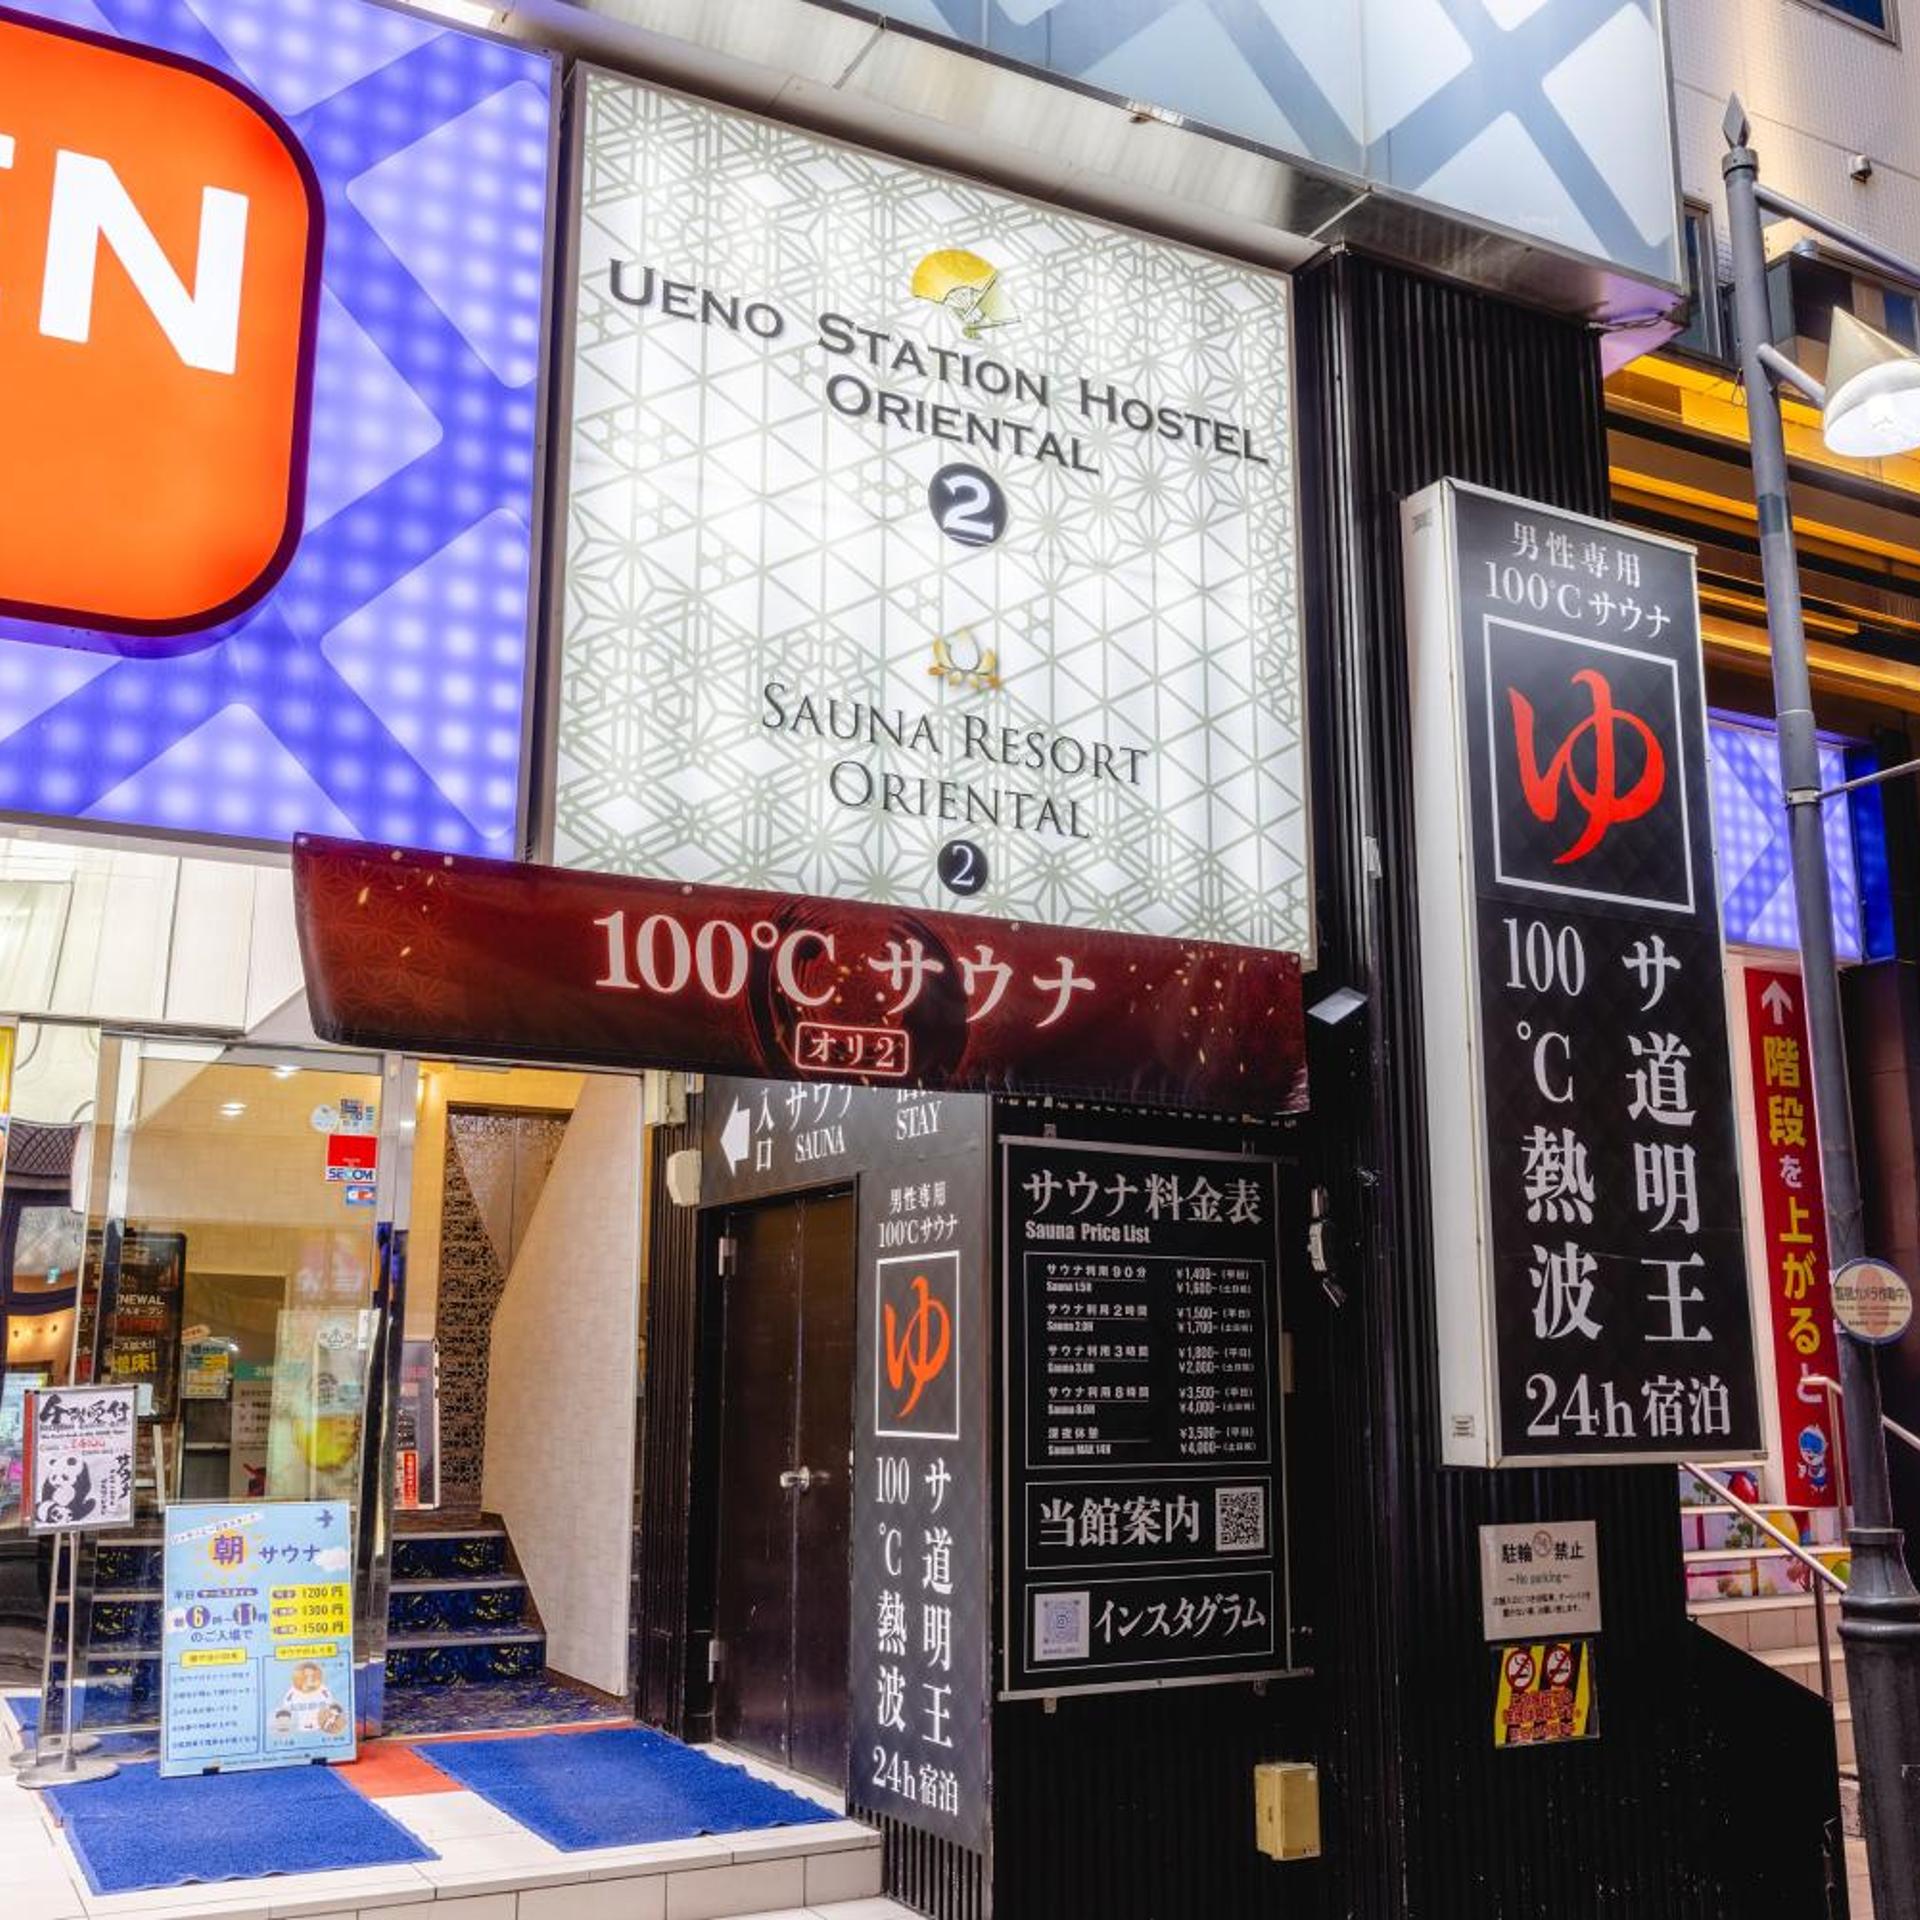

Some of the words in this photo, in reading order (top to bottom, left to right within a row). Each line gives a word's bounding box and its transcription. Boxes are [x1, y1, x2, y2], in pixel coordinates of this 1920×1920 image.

[609, 259, 783, 339] UENO
[818, 312, 1049, 406] STATION
[1078, 376, 1270, 463] HOSTEL
[826, 373, 1099, 474] ORIENTAL
[943, 476, 996, 542] 2
[1513, 520, 1641, 588] 男性専用
[762, 682, 940, 754] SAUNA
[963, 713, 1148, 786] RESORT
[1508, 669, 1665, 865] ゆ
[829, 760, 1091, 838] ORIENTAL
[948, 848, 976, 886] 2
[807, 1031, 895, 1068] オリ2
[755, 1088, 775, 1173] 入口
[795, 1124, 846, 1163] SAUNA
[896, 1101, 942, 1140] STAY
[1622, 935, 1713, 1342] サ道明王
[328, 1168, 373, 1180] SECOM
[889, 1181, 947, 1215] 男性専用
[1022, 1170, 1262, 1225] サウナ料金表
[1026, 1220, 1075, 1240] Sauna
[1081, 1223, 1120, 1242] Price
[1123, 1224, 1151, 1243] List
[884, 1275, 950, 1418] ゆ
[1039, 1495, 1199, 1547] 当館案内
[212, 1535, 244, 1565] 朝
[258, 1544, 321, 1564] サウナ
[1555, 1541, 1585, 1561] 禁止
[922, 1457, 953, 1748] サ道明王
[1095, 1593, 1266, 1644] インスタグラム
